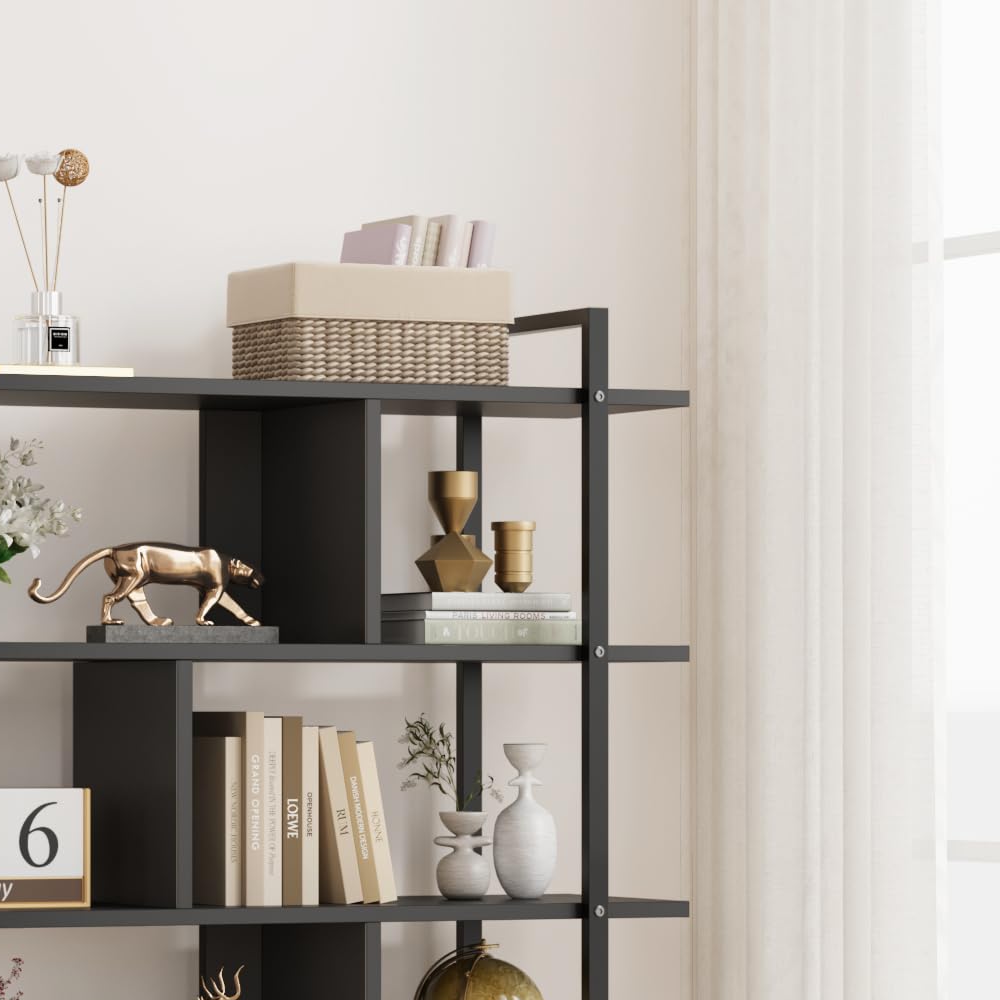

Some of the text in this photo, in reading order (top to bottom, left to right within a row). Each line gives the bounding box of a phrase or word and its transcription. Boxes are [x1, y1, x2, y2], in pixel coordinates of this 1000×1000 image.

[481, 612, 511, 621] LIVING
[513, 612, 546, 621] ROOMS
[251, 754, 261, 851] GRAND OPENING
[287, 798, 299, 839] LOEWE
[336, 808, 349, 836] RUM
[349, 776, 360, 803] DANISH
[359, 834, 369, 860] DESIGN
